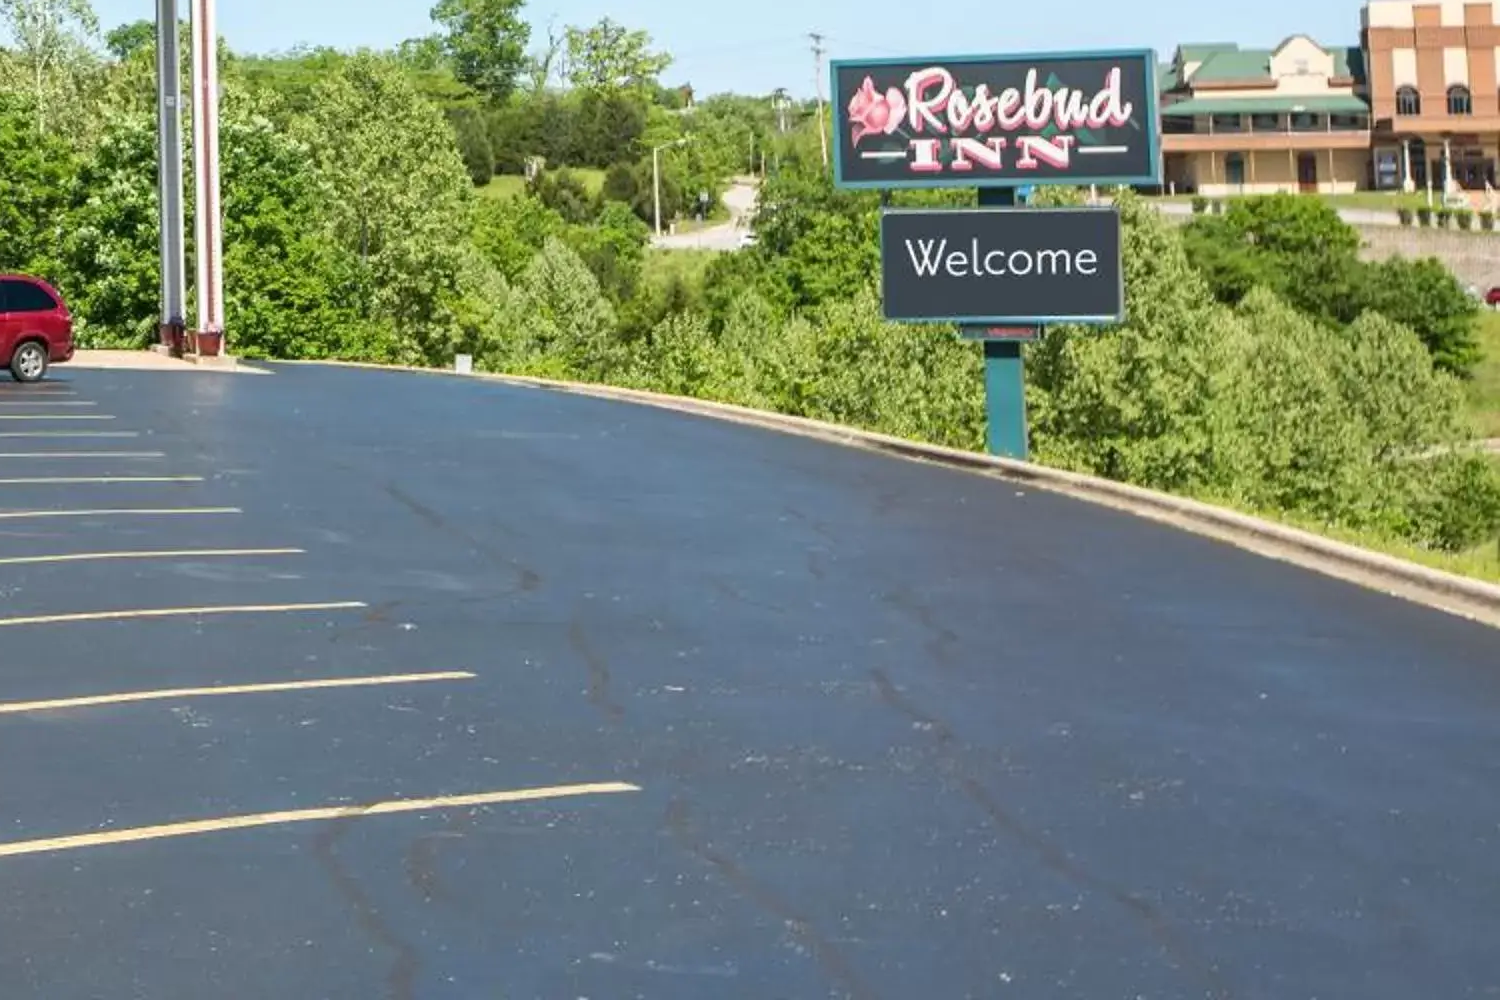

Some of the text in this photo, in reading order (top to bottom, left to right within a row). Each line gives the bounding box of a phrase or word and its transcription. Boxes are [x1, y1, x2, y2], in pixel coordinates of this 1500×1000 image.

[904, 66, 1132, 132] Rosebud
[910, 135, 1075, 171] INN
[904, 238, 1098, 277] Welcome
